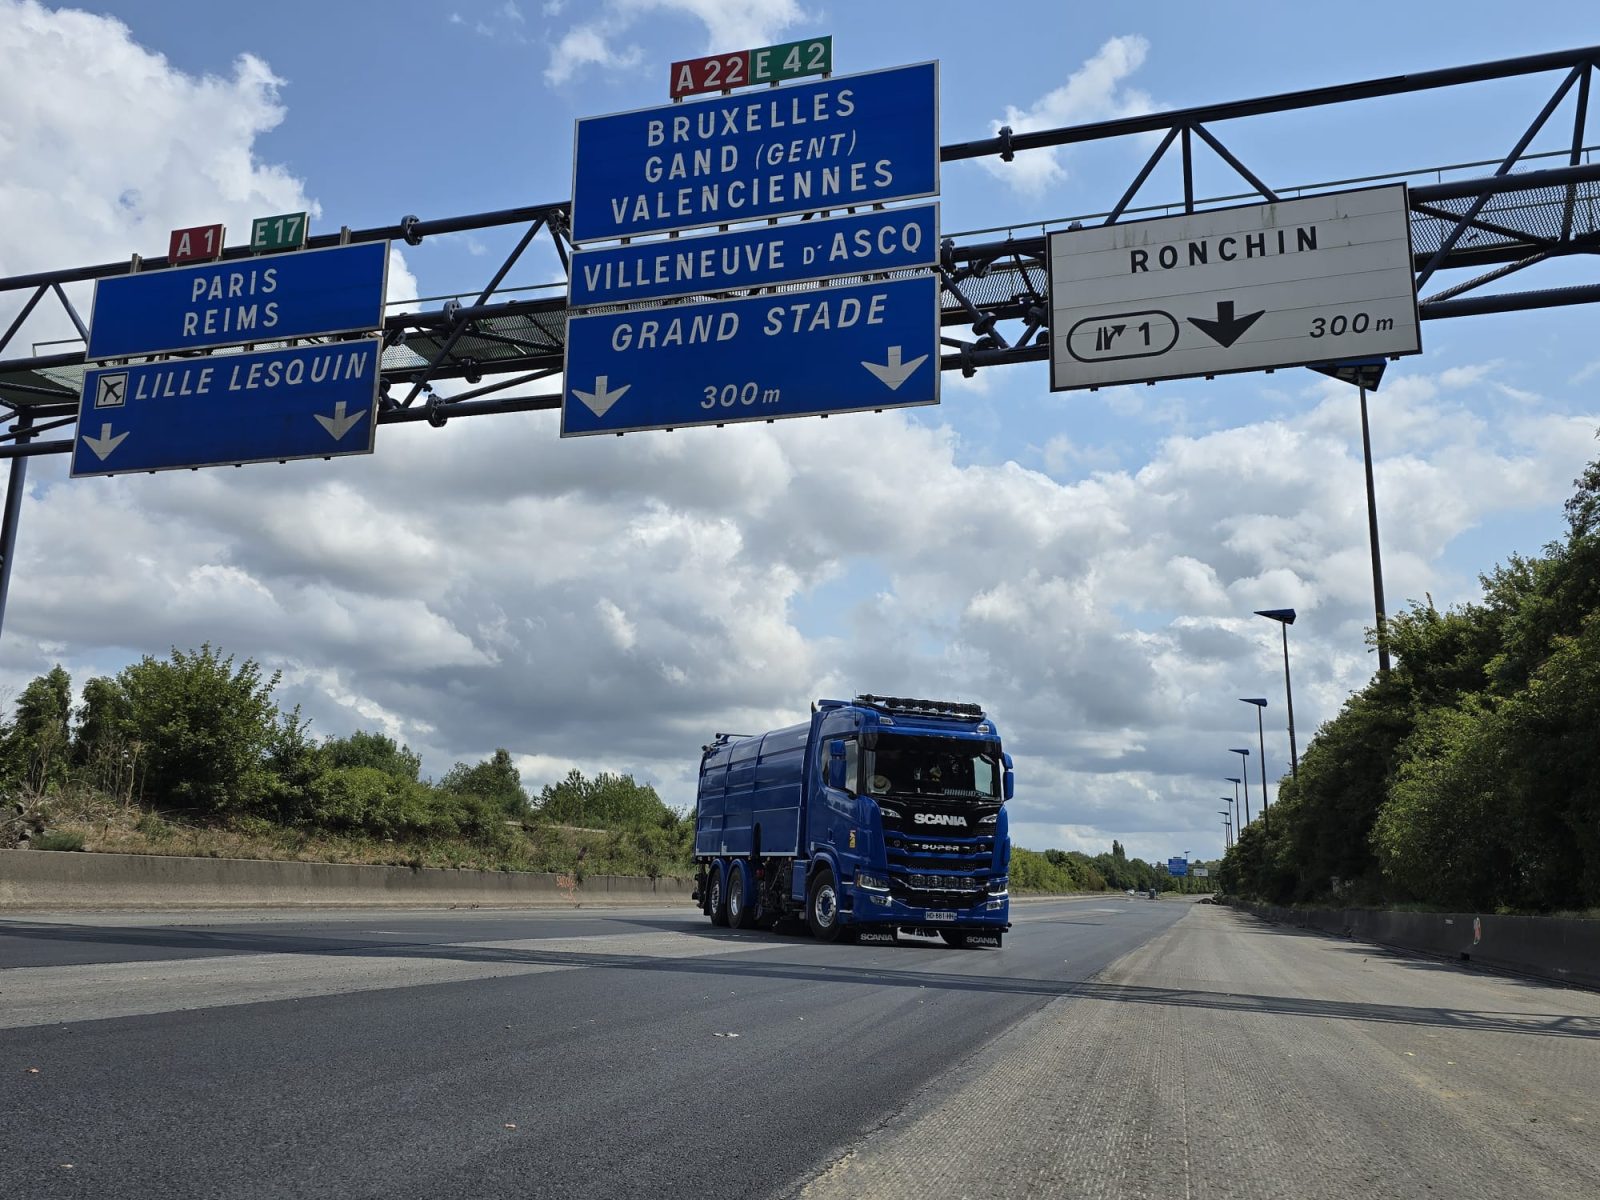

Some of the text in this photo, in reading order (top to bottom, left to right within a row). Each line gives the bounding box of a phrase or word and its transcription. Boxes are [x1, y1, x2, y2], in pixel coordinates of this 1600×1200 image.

[677, 56, 744, 92] A 22
[756, 42, 826, 79] E 42
[647, 89, 855, 147] BRUXELLES
[645, 129, 858, 184] GAND (GENT)
[611, 159, 893, 225] VALENCIENNES
[176, 229, 214, 257] A 1
[254, 216, 302, 247] E 17
[1130, 225, 1318, 274] RONCHIN
[584, 240, 784, 292] VILLENEUVE
[191, 268, 277, 303] PARIS
[182, 302, 279, 337] REIMS
[611, 294, 888, 352] GRAND STADE
[1138, 321, 1151, 346] 1
[135, 352, 368, 400] LILLE LESQUIN
[914, 813, 968, 827] SCANIA
[860, 933, 894, 941] SCANIA
[966, 936, 999, 945] SCANIA
